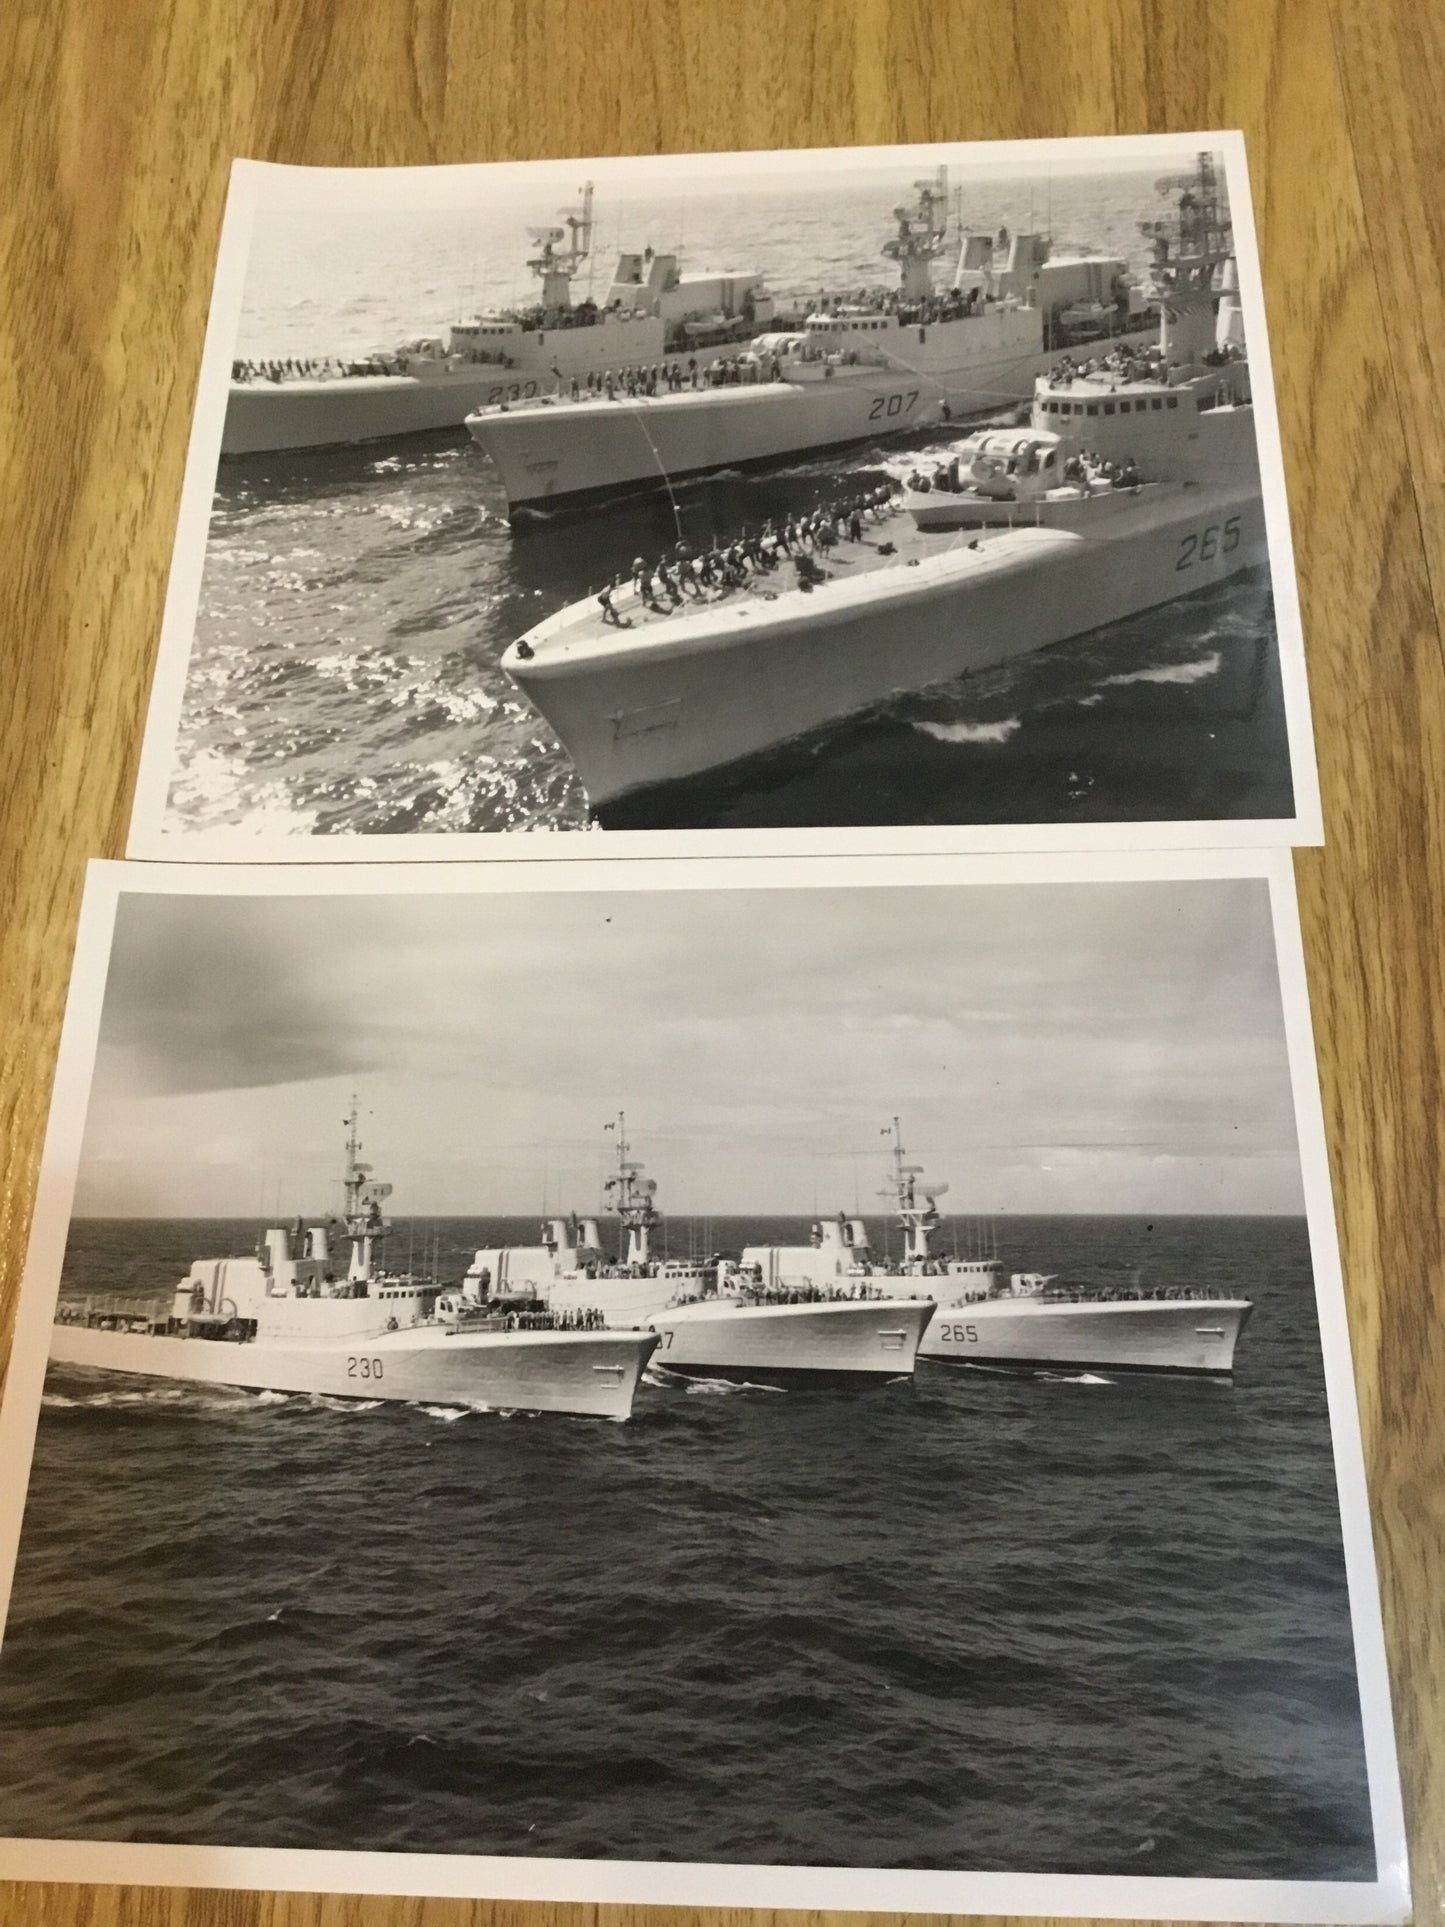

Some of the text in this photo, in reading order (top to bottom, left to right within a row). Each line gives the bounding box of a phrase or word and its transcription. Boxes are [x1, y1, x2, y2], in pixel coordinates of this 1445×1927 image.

[488, 380, 537, 405] 230
[869, 390, 919, 420] 207
[1176, 515, 1241, 571] 265
[940, 1324, 978, 1342] 265
[347, 1356, 384, 1379] 230
